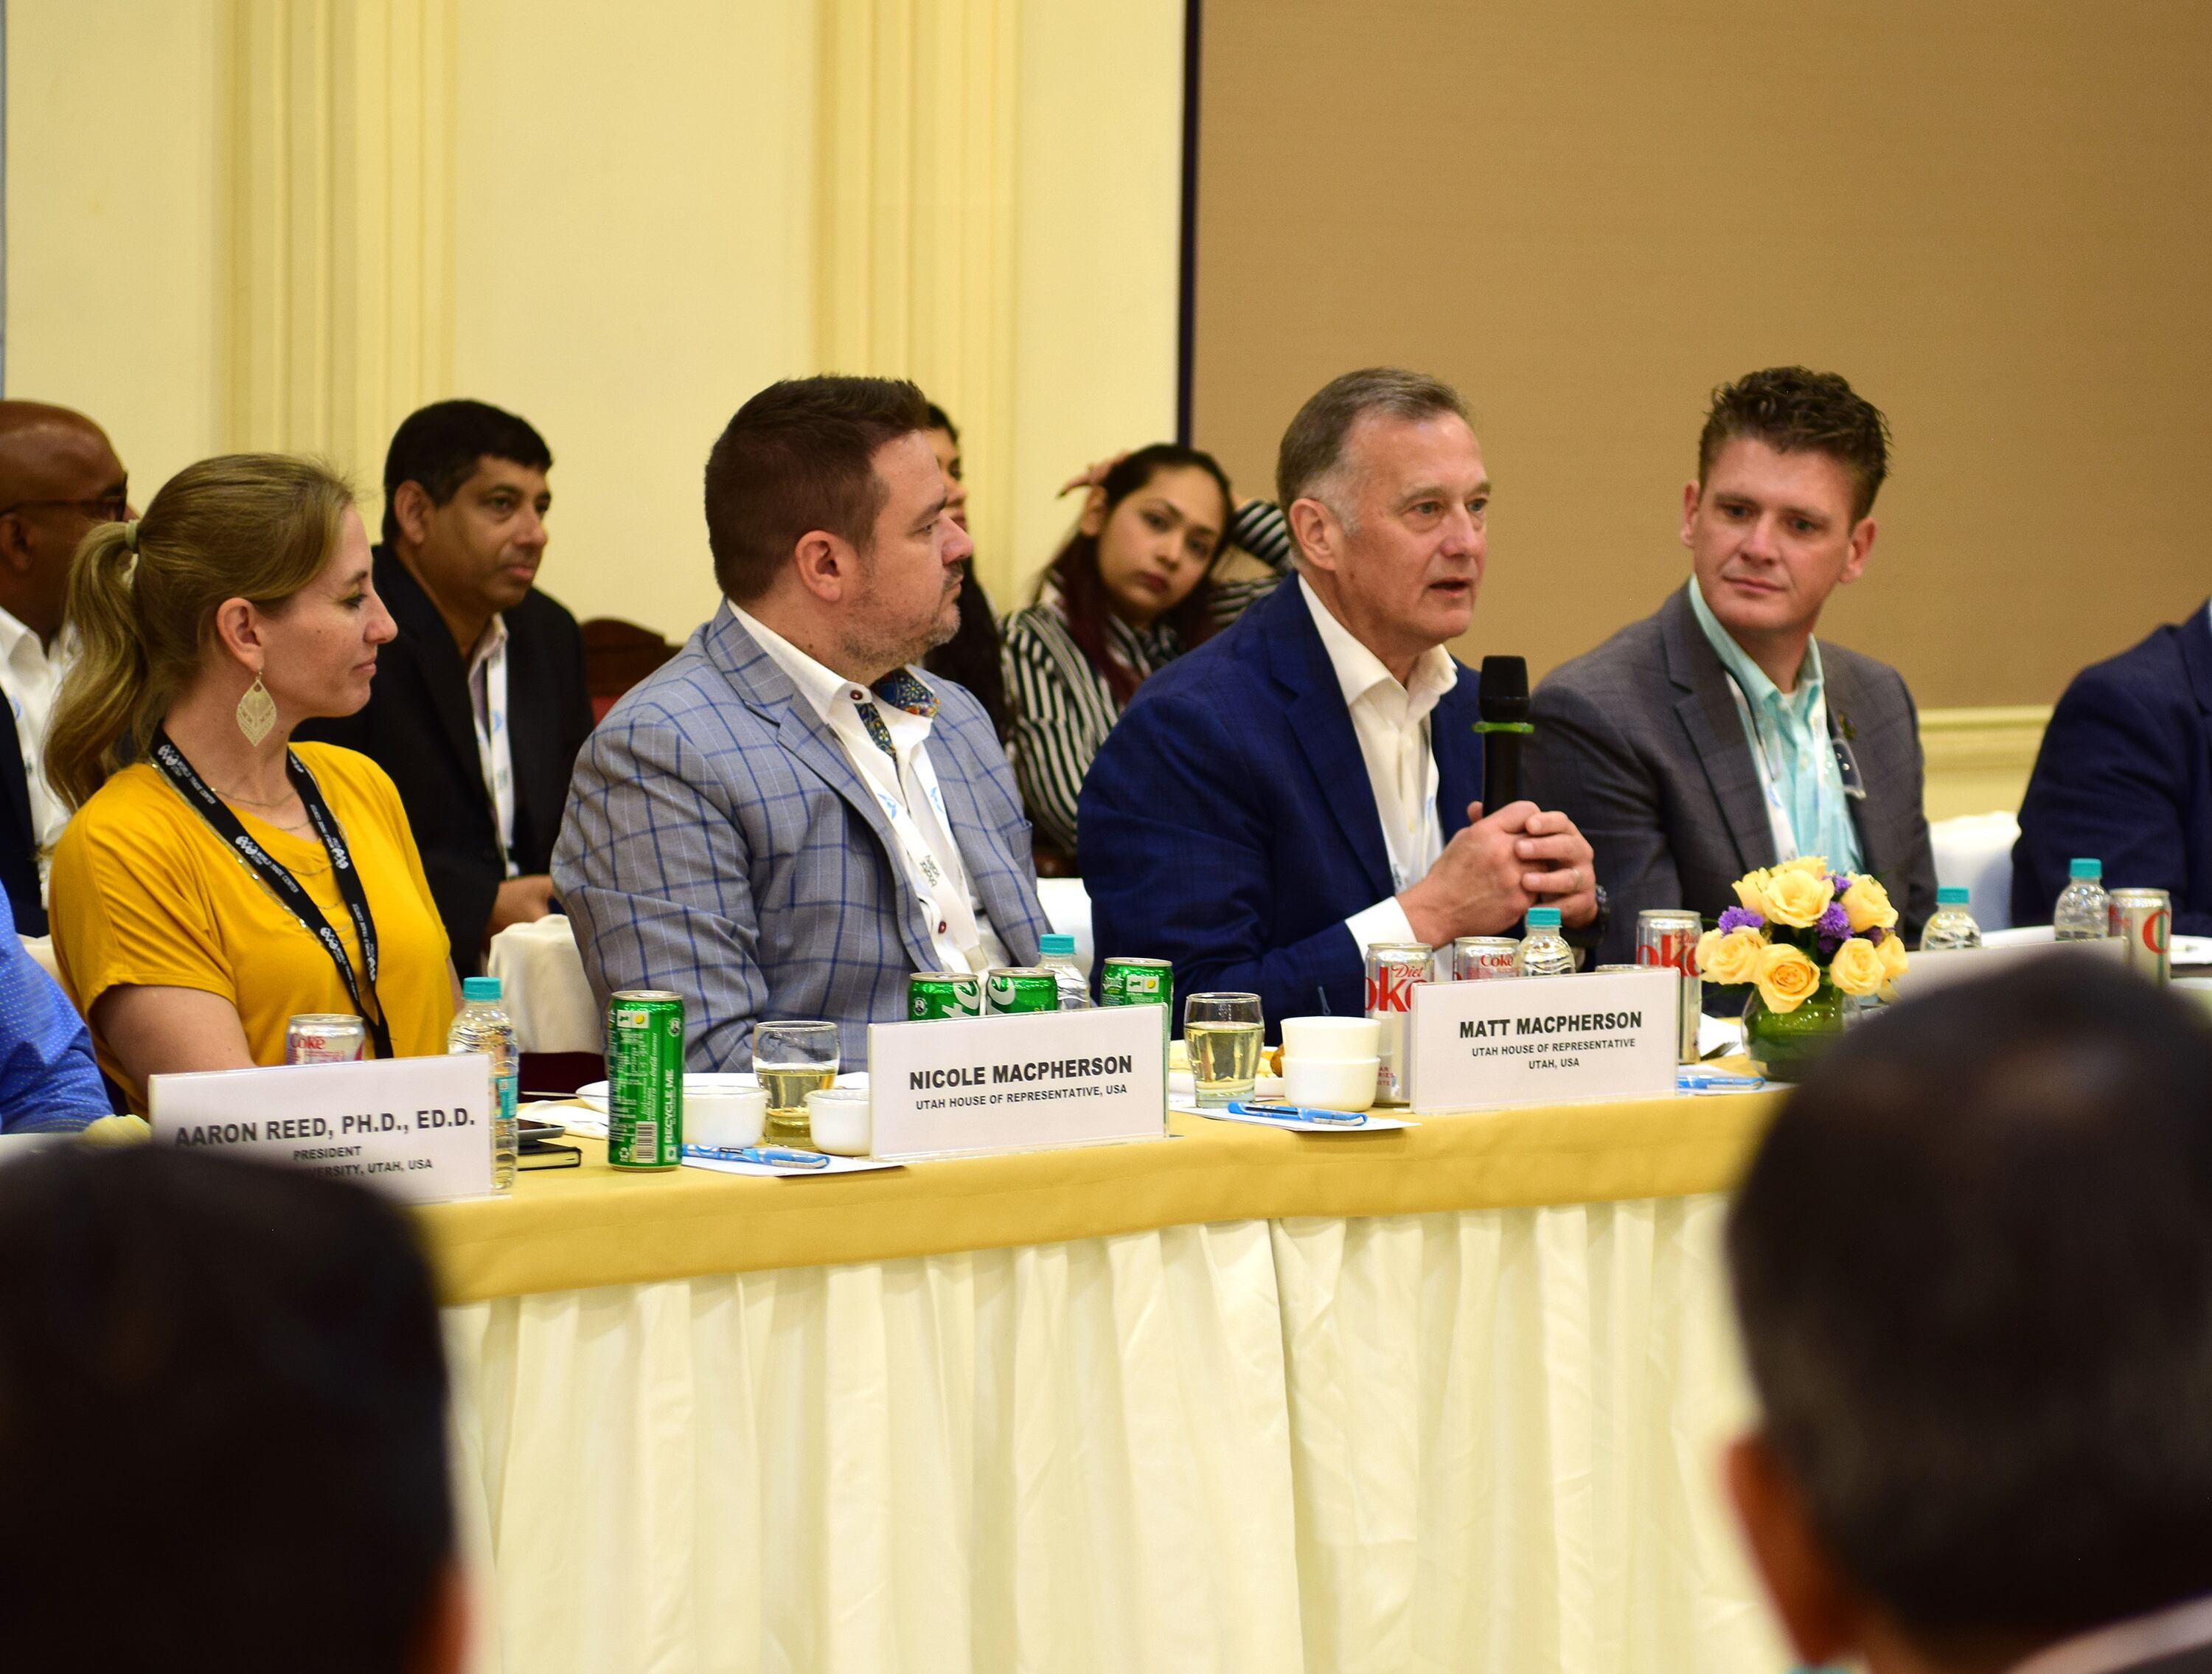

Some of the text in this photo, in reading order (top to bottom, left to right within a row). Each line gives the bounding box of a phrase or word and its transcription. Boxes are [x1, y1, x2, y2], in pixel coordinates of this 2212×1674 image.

[1391, 962, 1425, 978] Diet
[1481, 953, 1514, 968] Coke
[1460, 1011, 1641, 1038] MATT MACPHERSON
[1472, 1038, 1635, 1057] UTAH HOUSE OF REPRESENTATIVE
[910, 1055, 1132, 1090] NICOLE MACPHERSON
[1528, 1057, 1579, 1069] UTAH, USA
[664, 1069, 674, 1143] RECYCLE ME
[916, 1084, 1127, 1110] UTAH HOUSE OF REPRESENTATIVE, USA
[175, 1108, 475, 1146] AARON REED, PH.D., ED.D.
[294, 1146, 361, 1160] PRESIDENT
[304, 1159, 433, 1178] VERSITY, UTAH, USA
